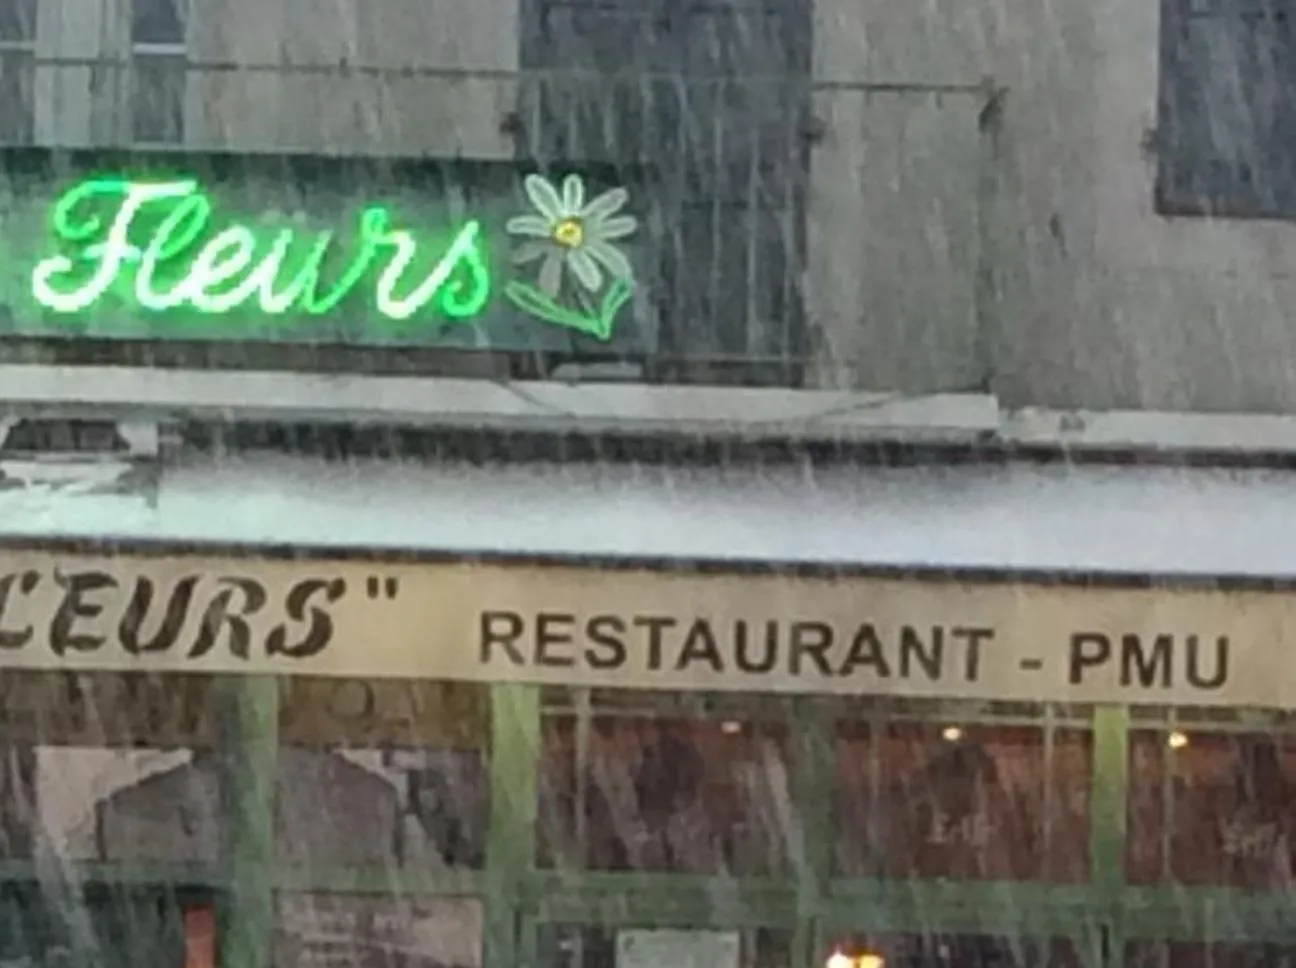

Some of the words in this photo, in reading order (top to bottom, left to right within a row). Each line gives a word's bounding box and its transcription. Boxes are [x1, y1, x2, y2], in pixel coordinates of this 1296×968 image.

[31, 178, 490, 320] Fleurs
[478, 610, 994, 681] RESTAURANT
[1068, 631, 1231, 690] PMU
